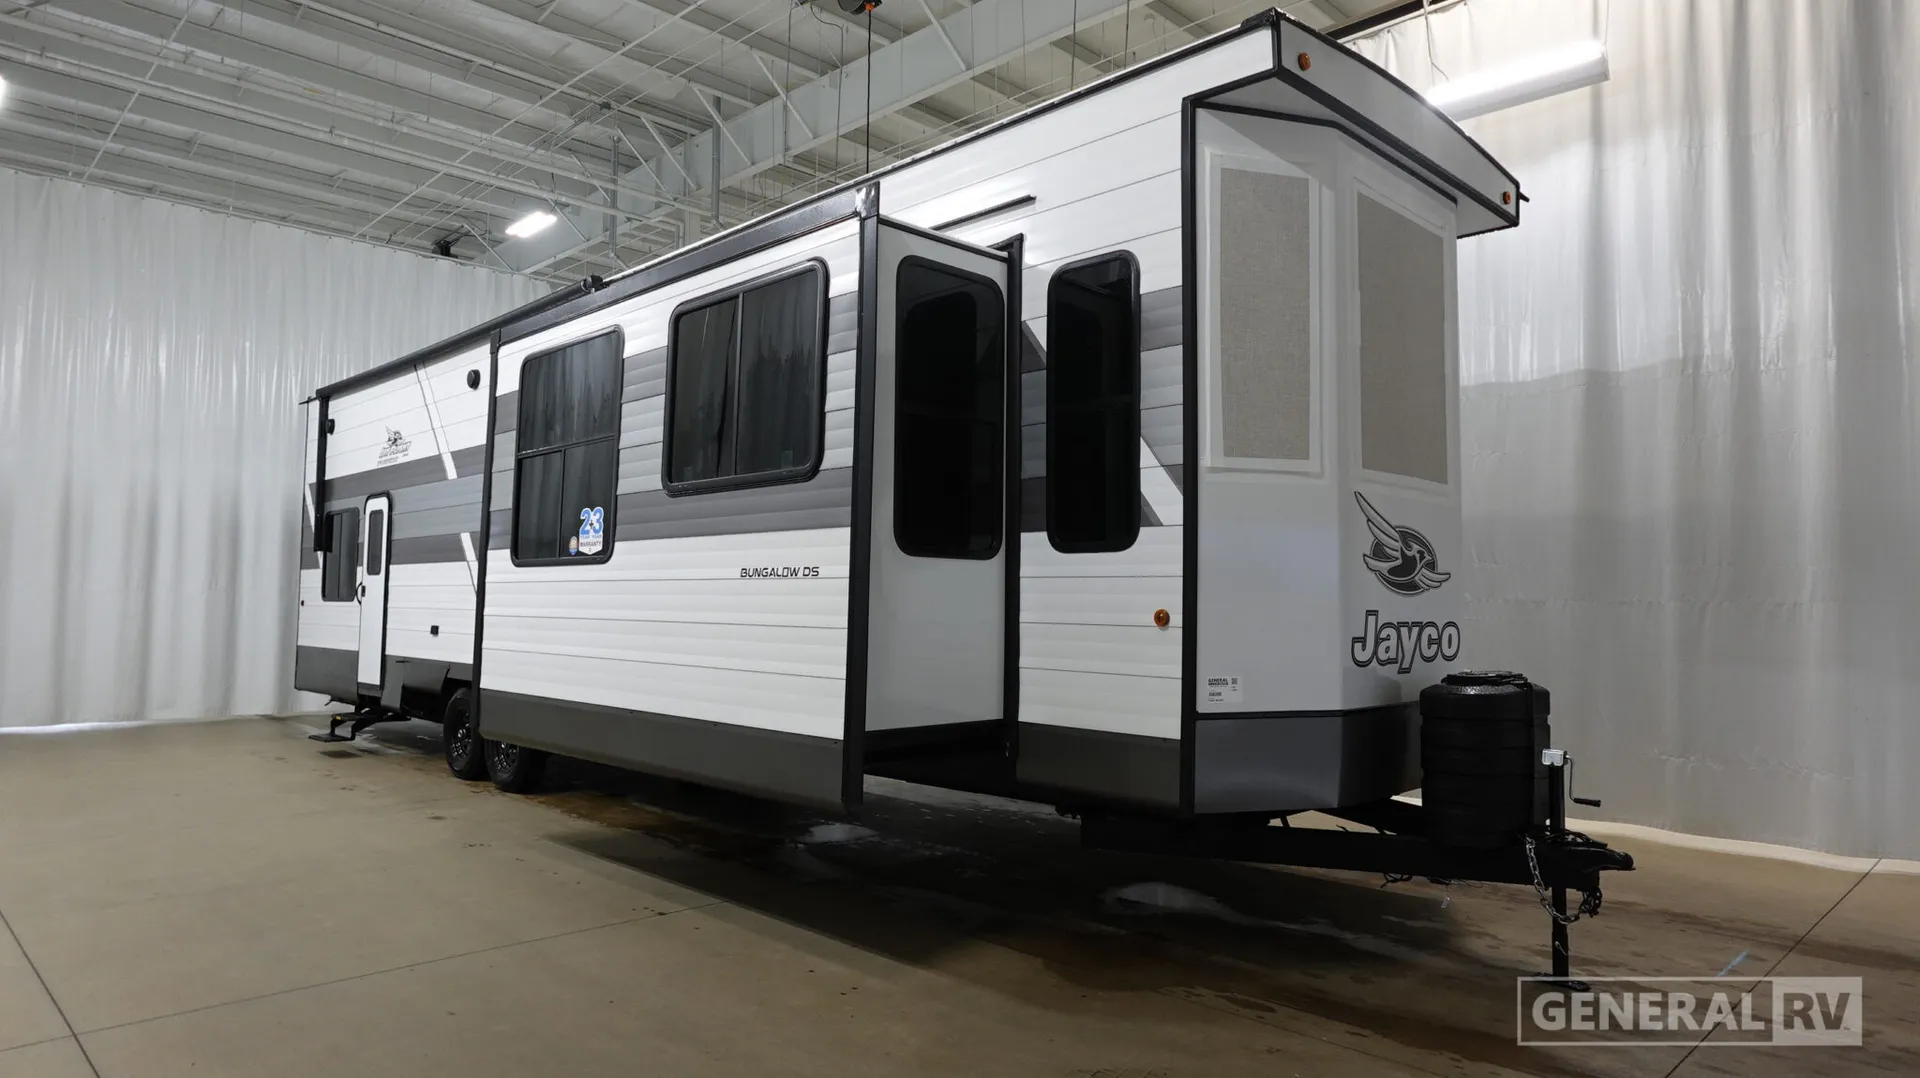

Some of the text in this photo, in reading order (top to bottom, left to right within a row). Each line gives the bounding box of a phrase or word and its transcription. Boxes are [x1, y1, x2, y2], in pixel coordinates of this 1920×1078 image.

[740, 566, 820, 577] BUNGALOW DS
[1351, 610, 1460, 674] Jayco
